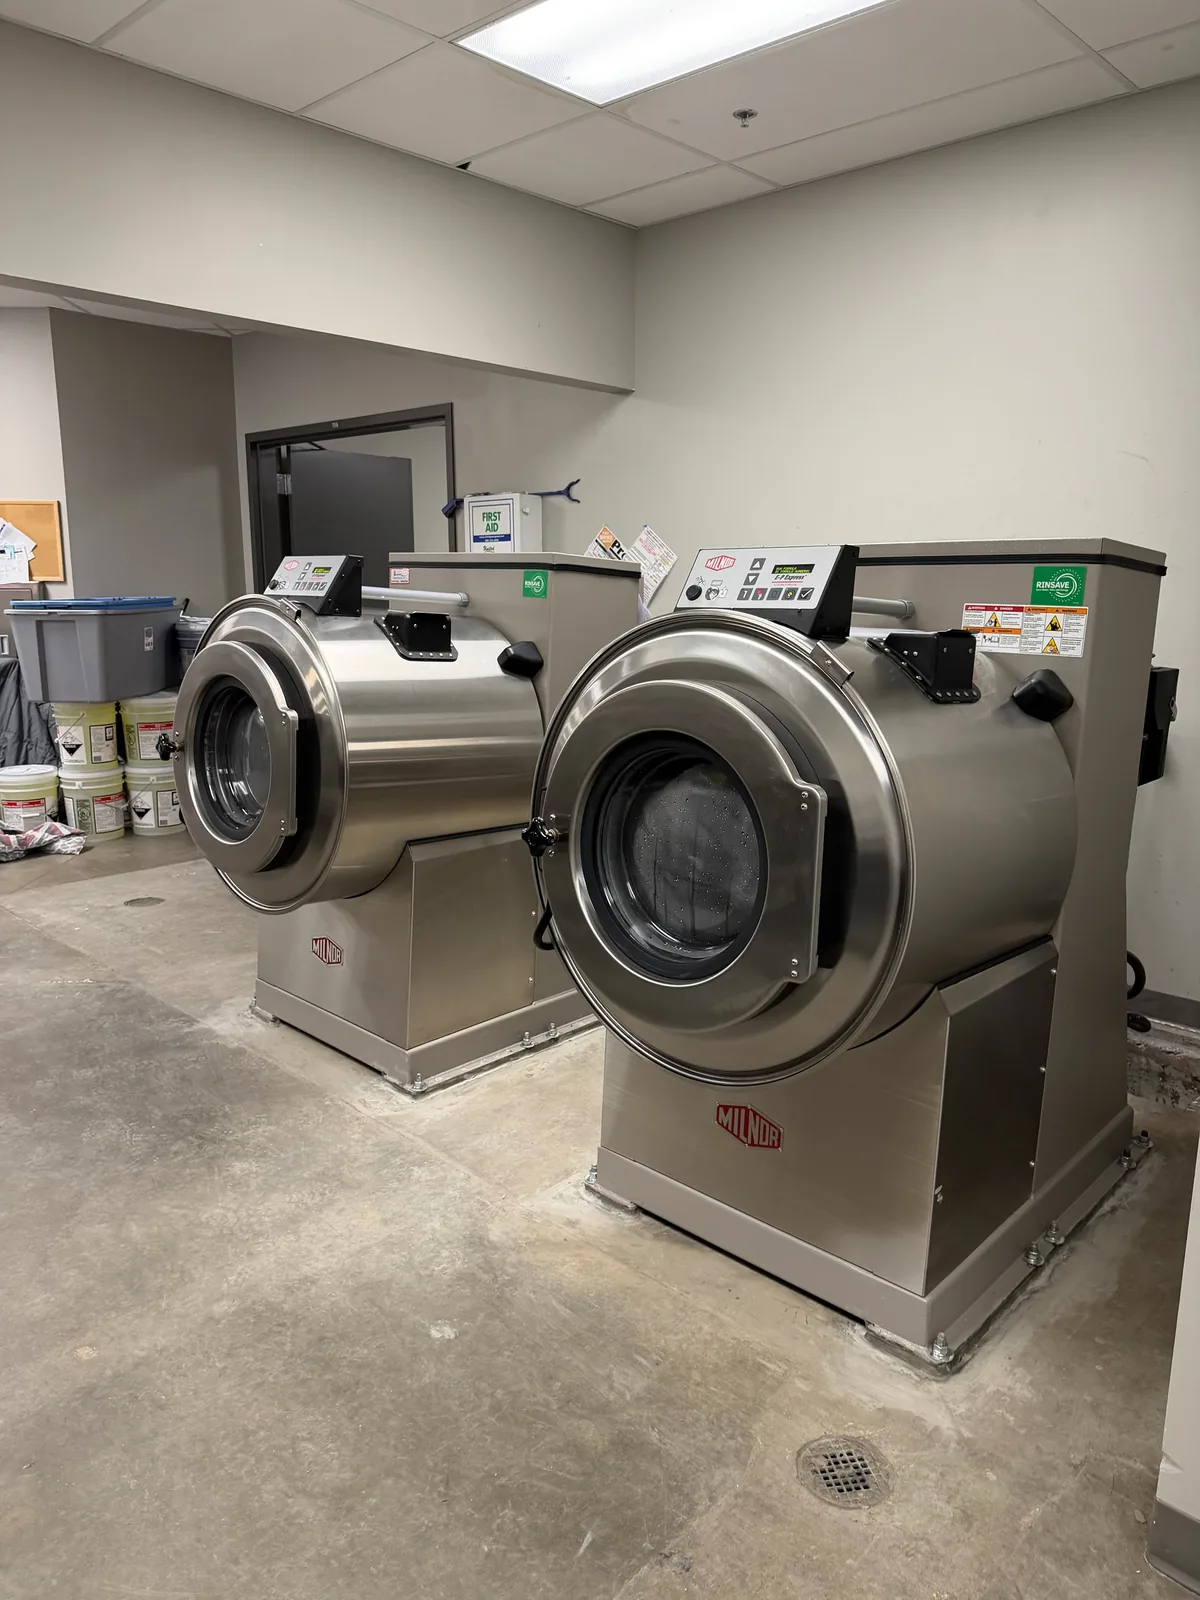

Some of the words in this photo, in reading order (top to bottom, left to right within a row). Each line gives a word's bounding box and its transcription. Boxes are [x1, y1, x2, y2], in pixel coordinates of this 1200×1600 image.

[482, 511, 501, 522] FIRST
[485, 522, 499, 533] AID
[705, 556, 735, 570] MILNOR
[1036, 581, 1070, 589] RINSAVE
[312, 937, 341, 964] MILNOR
[718, 1105, 780, 1148] MILNOR
